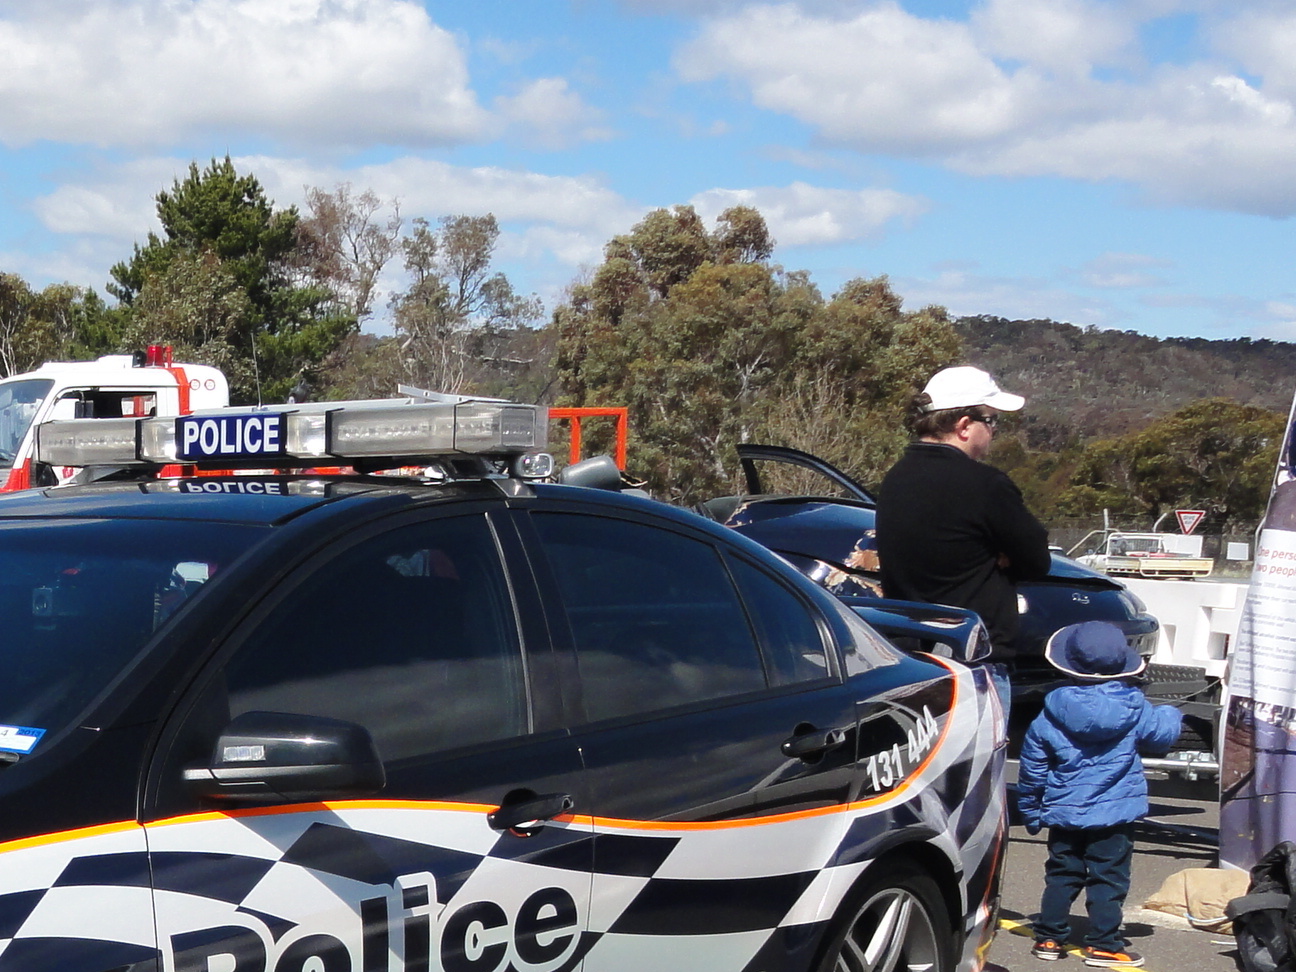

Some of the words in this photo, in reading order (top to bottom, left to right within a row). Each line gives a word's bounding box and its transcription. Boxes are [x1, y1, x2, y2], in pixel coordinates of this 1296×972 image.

[184, 417, 280, 455] POLICE
[866, 743, 904, 792] 131
[907, 704, 939, 764] 444
